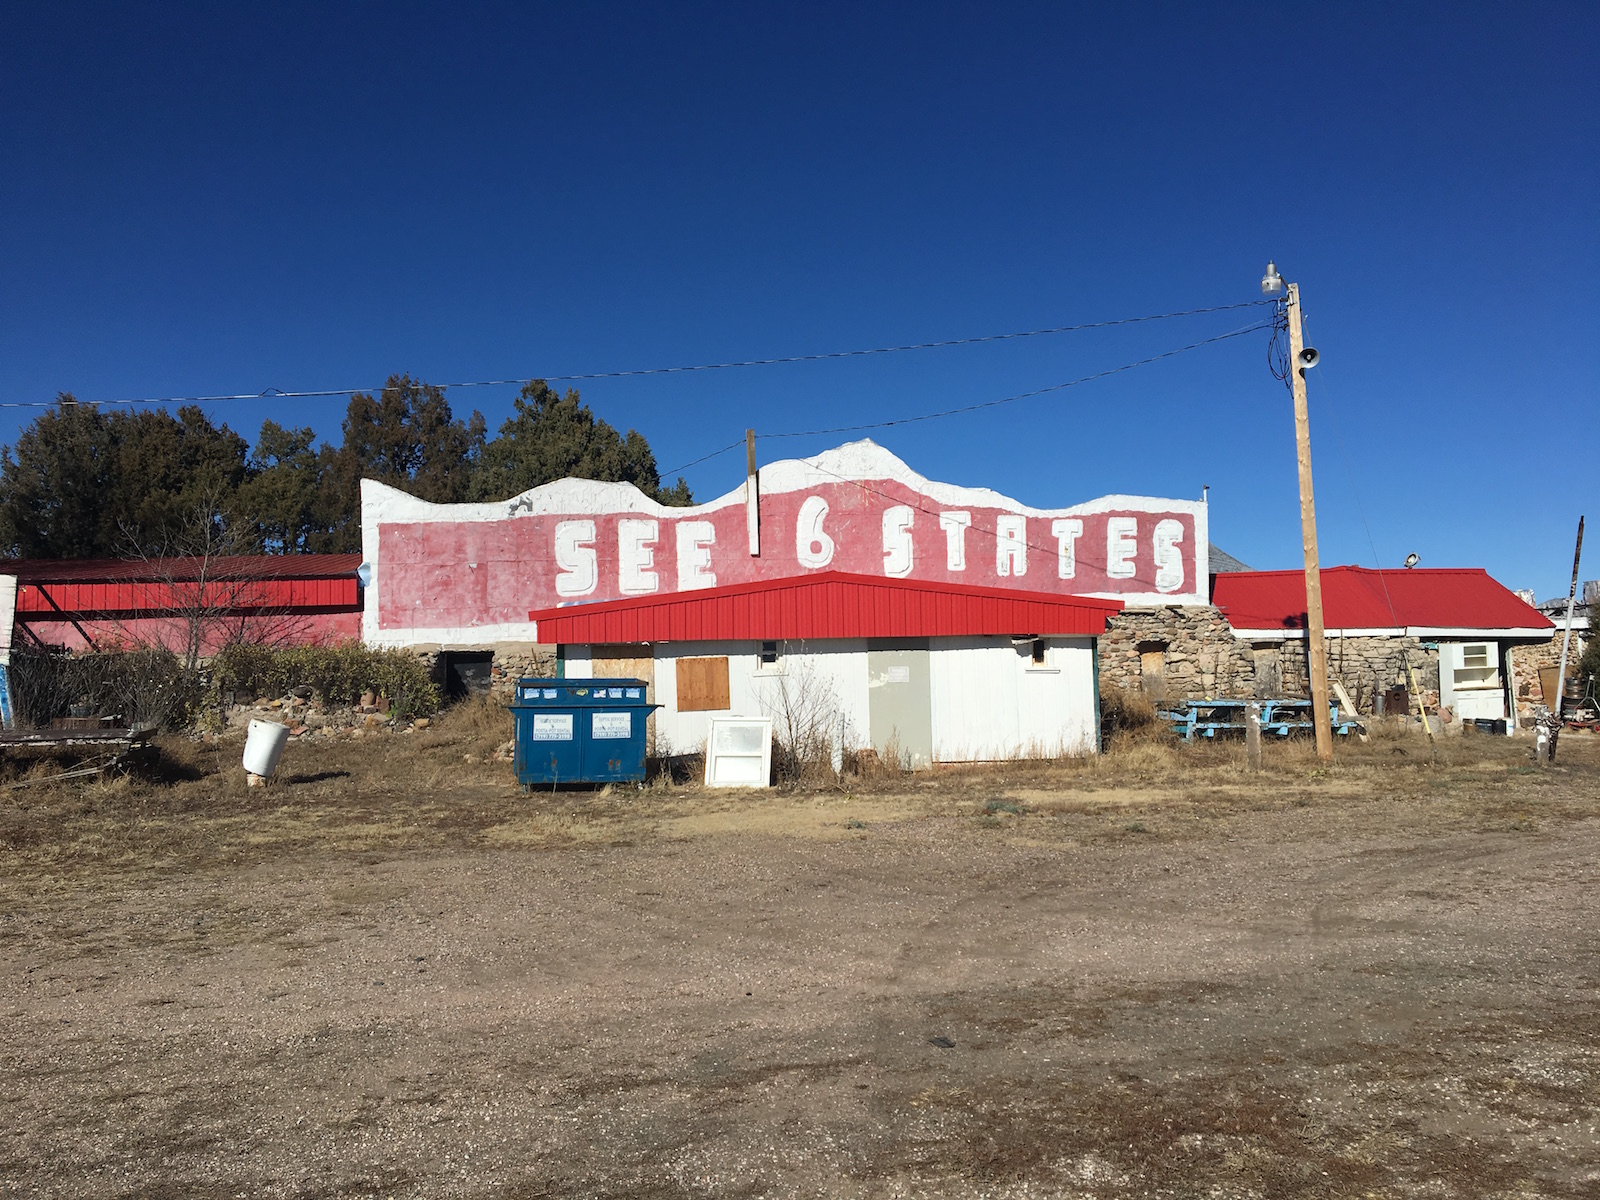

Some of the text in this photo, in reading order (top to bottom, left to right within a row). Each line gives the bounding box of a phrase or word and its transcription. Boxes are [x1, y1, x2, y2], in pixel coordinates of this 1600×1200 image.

[554, 495, 1184, 597] SEE 6 STATES
